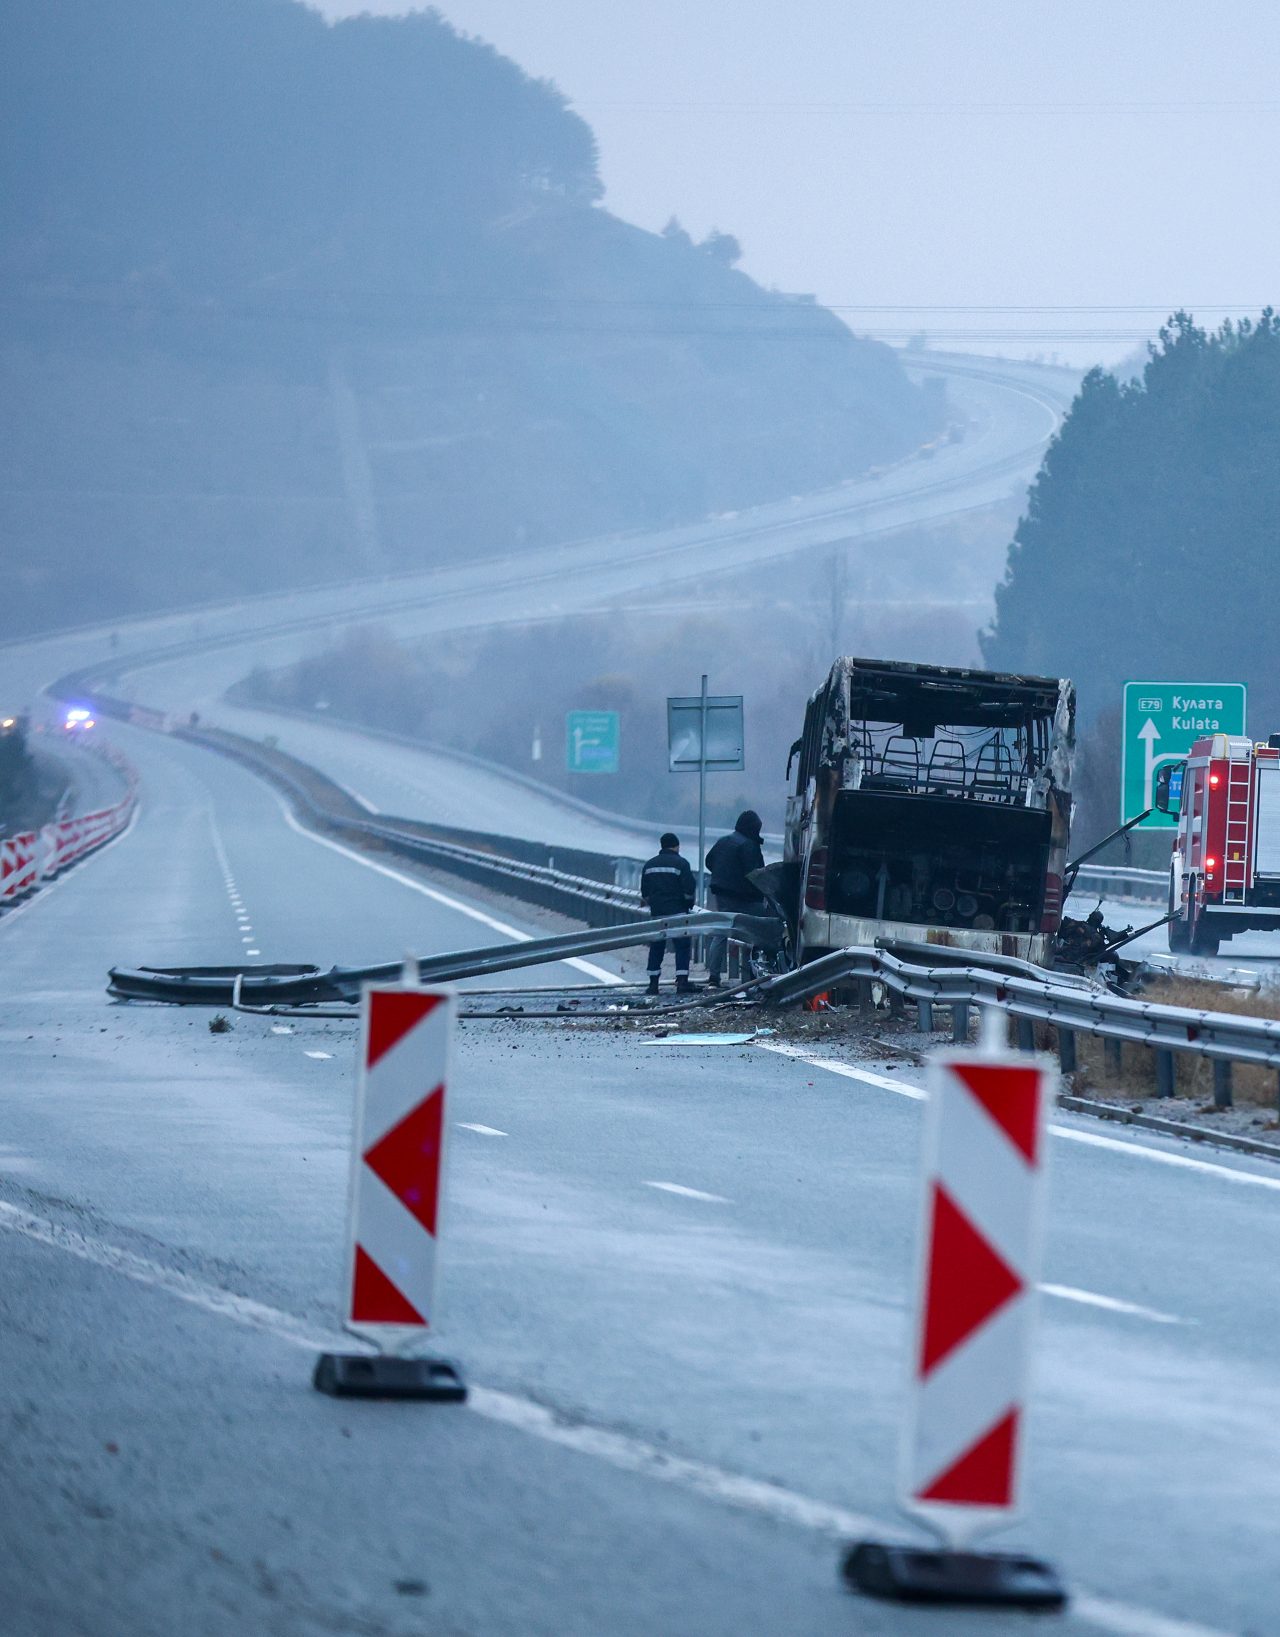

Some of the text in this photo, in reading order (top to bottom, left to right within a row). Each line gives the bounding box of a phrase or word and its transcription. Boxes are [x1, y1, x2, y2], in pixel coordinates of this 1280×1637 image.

[1141, 700, 1160, 709] E79
[1172, 696, 1223, 712] Кулата
[1172, 716, 1219, 730] Kulata
